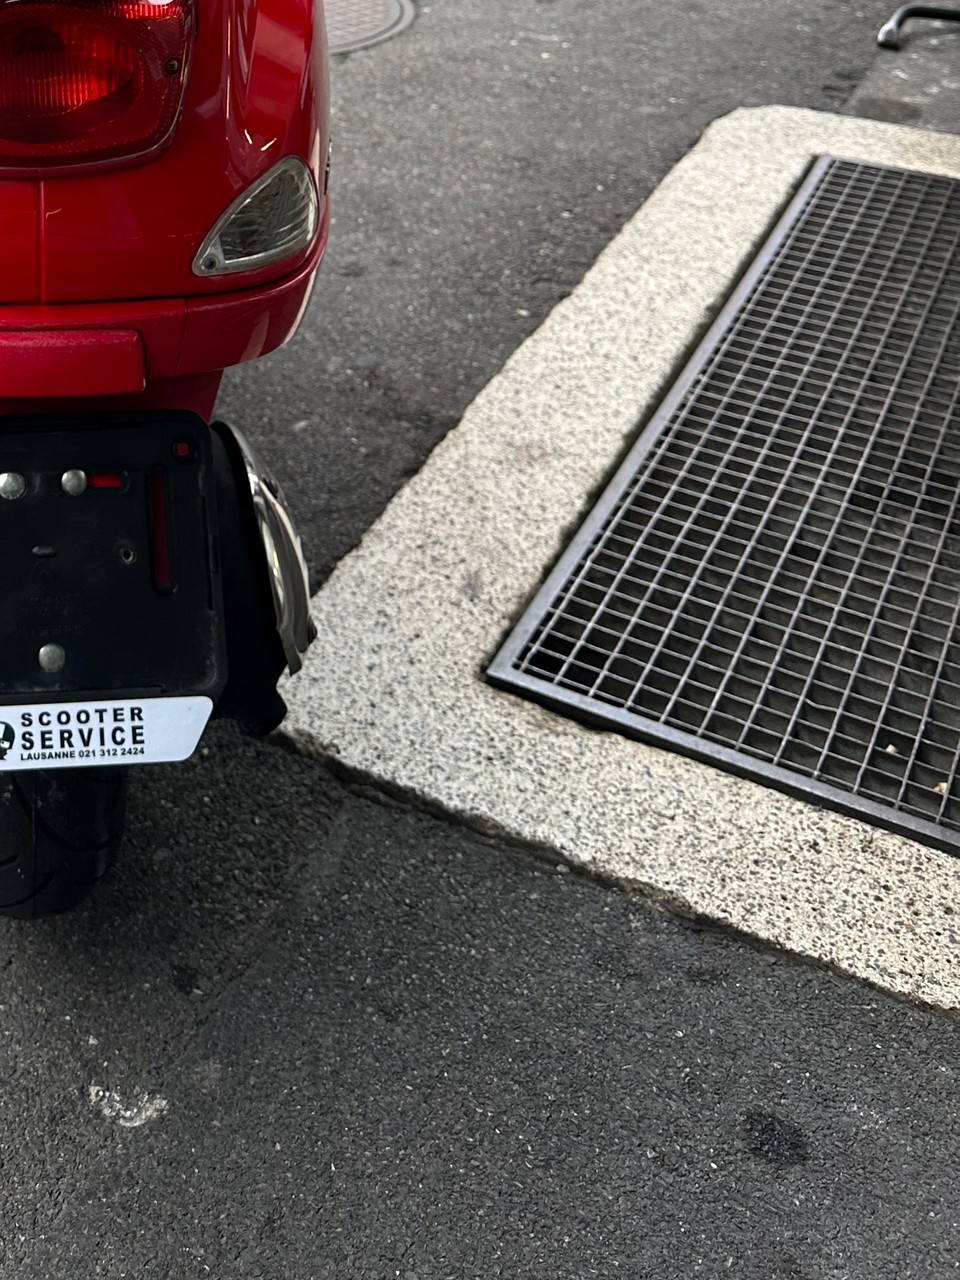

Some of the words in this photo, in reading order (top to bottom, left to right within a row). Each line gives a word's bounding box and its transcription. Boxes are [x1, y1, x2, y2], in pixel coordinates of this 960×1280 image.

[21, 706, 144, 727] SCOOTER
[21, 725, 145, 751] SERVICE
[20, 750, 76, 761] LAUSANNE
[78, 749, 96, 758] 021
[100, 748, 118, 757] 312
[120, 747, 145, 757] 2424
